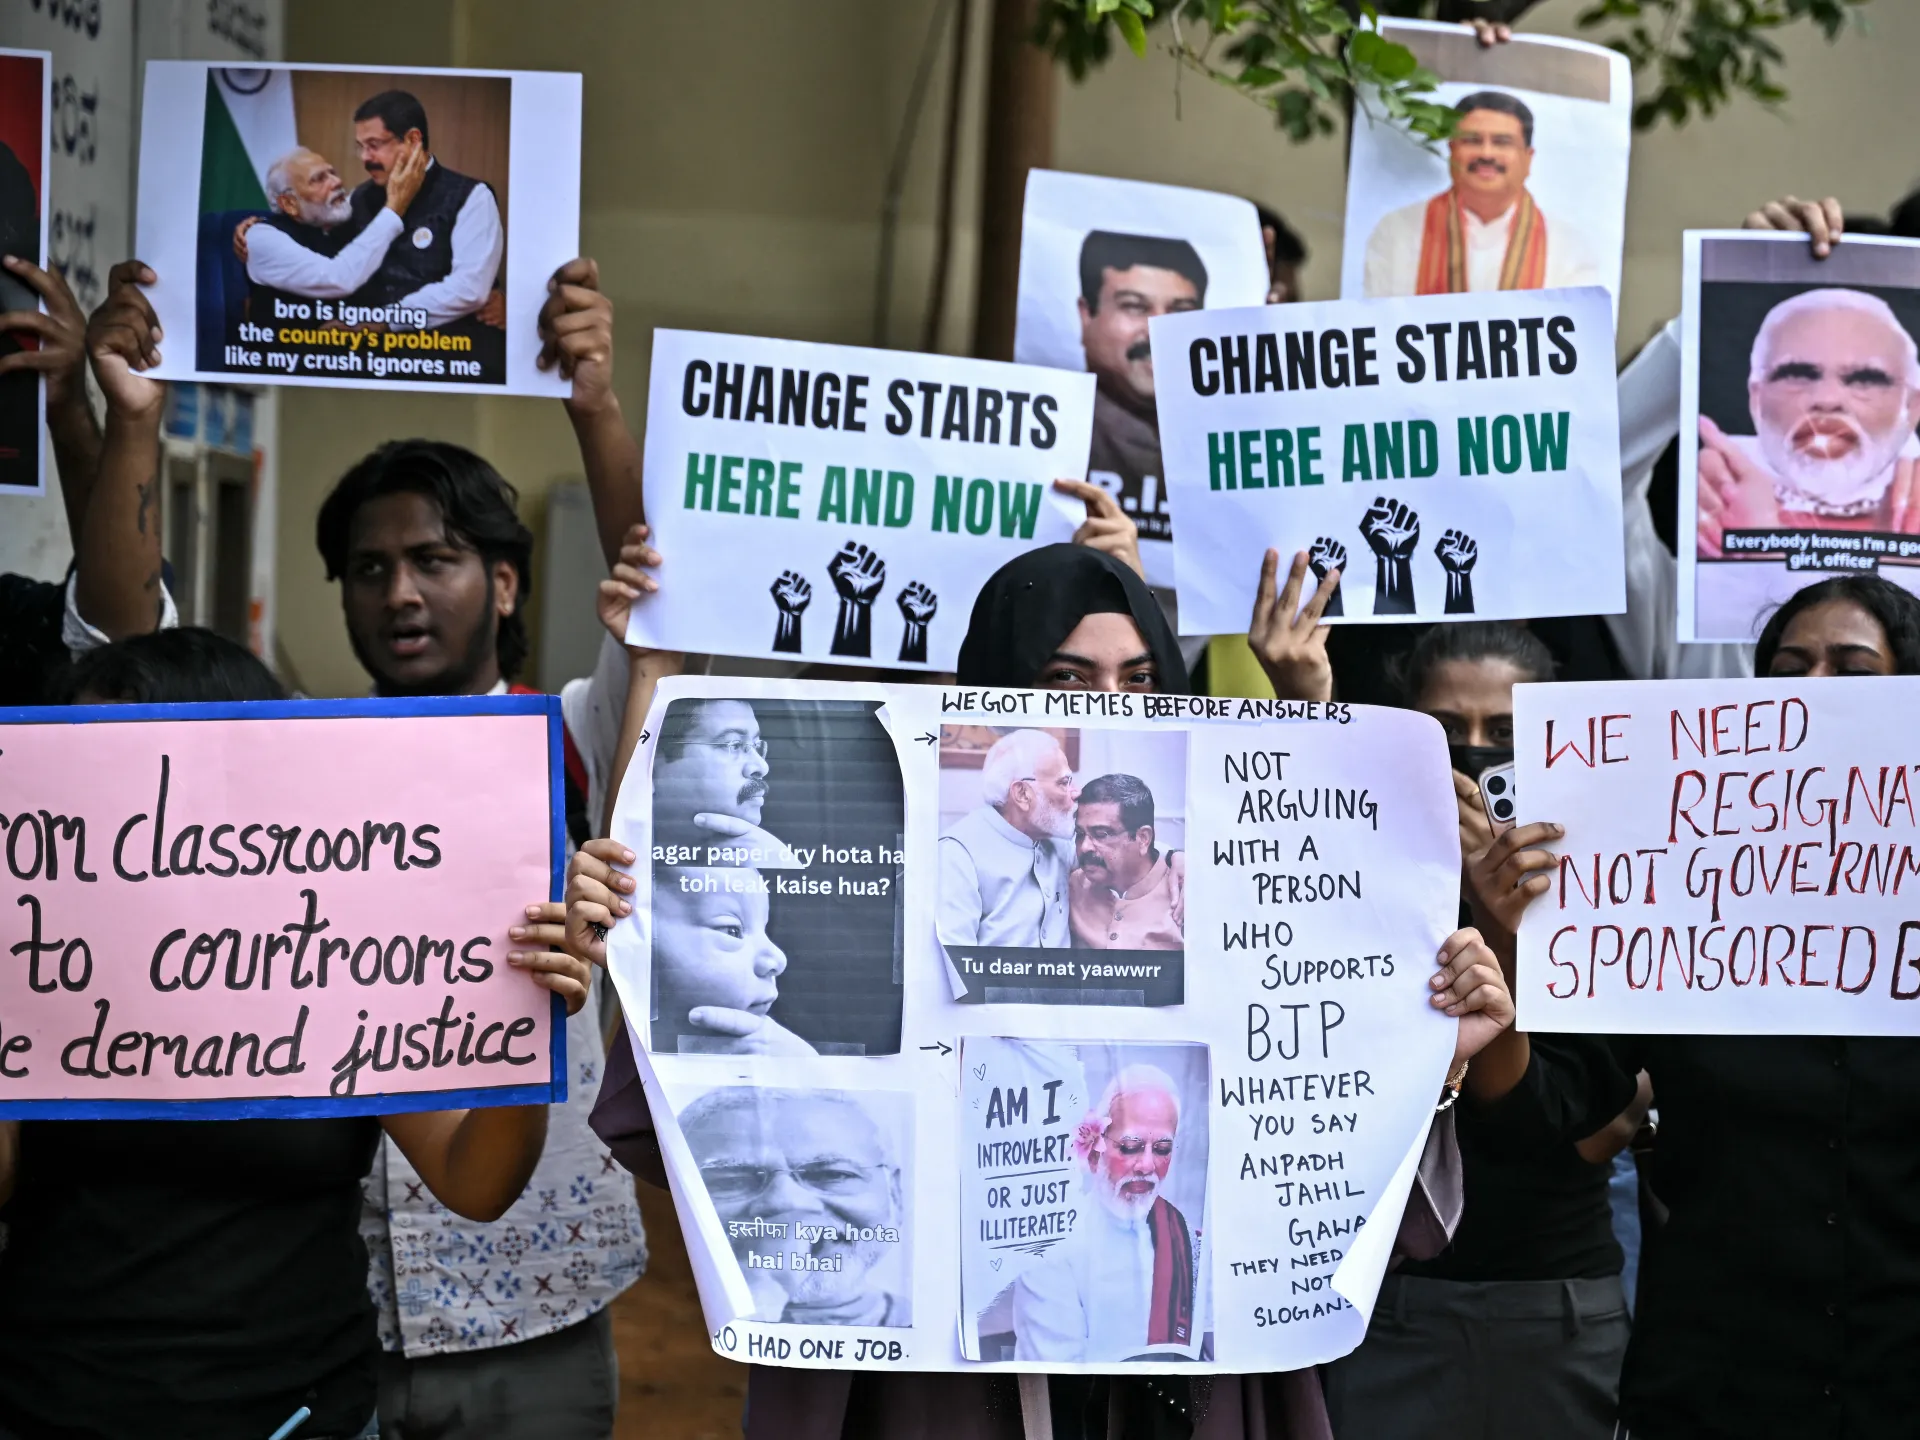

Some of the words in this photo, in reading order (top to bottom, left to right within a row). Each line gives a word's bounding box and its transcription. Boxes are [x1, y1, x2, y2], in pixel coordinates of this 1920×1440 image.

[274, 299, 310, 320] bro
[316, 300, 333, 321] is
[339, 302, 427, 329] ignoring
[238, 323, 274, 343] the
[383, 331, 472, 352] problem
[224, 346, 262, 366] like
[267, 352, 299, 373] my
[304, 351, 362, 371] crush
[367, 352, 445, 377] ignores
[450, 360, 481, 376] me
[1189, 326, 1380, 397] CHANGE
[1396, 315, 1578, 384] STARTS
[682, 358, 869, 433] CHANGE
[885, 378, 1058, 450] STARTS
[1207, 426, 1325, 491] HERE
[1341, 419, 1439, 483] AND
[1457, 411, 1570, 476] NOW
[683, 452, 803, 519] HERE
[817, 465, 915, 530] AND
[931, 474, 1043, 540] NOW
[1725, 533, 1810, 552] Everybody
[1811, 535, 1861, 551] knows
[1888, 541, 1897, 552] a
[1790, 552, 1822, 570] girl,
[1824, 552, 1876, 569] officer
[1045, 693, 1134, 718] MEMES
[1237, 698, 1352, 725] ANSWERS
[1545, 713, 1631, 769] WE
[1670, 697, 1809, 761] NEED
[1225, 751, 1290, 783] NOT
[113, 754, 442, 882] classrooms
[1237, 788, 1378, 831] ARGUING
[652, 845, 701, 865] agar
[707, 846, 772, 866] paper
[778, 844, 816, 868] dry
[822, 845, 875, 865] hota
[1214, 839, 1279, 866] WITH
[1298, 835, 1319, 862] A
[680, 874, 718, 893] toh
[725, 875, 770, 894] leak
[776, 875, 832, 895] kaise
[838, 877, 891, 897] hua?
[1252, 870, 1361, 905] PERSON
[1559, 847, 1668, 910] NOT
[10, 894, 93, 993] to
[150, 889, 494, 992] courtrooms
[1223, 921, 1293, 951] WHO
[961, 957, 984, 974] Tu
[989, 958, 1033, 976] daar
[1037, 960, 1075, 977] mat
[1081, 962, 1162, 980] yaawwrr
[1261, 954, 1395, 991] SUPPORTS
[1546, 924, 1878, 999] SPONSORED
[61, 999, 310, 1079] demand
[330, 995, 536, 1097] justice
[1247, 1001, 1345, 1062] BJP
[985, 1086, 1028, 1129] AM
[1042, 1079, 1065, 1126] I
[1220, 1070, 1374, 1107] WHATEVER
[1249, 1114, 1295, 1141] YOU
[1312, 1112, 1358, 1135] SAY
[1240, 1151, 1345, 1180] ANPADH
[987, 1186, 1012, 1208] OR
[1021, 1180, 1070, 1206] JUST
[1274, 1180, 1365, 1207] JAHIL
[728, 1216, 789, 1240] इस्तीफा
[795, 1221, 839, 1244] kya
[845, 1222, 899, 1243] hota
[980, 1208, 1077, 1242] ILLITERATE?
[748, 1251, 784, 1270] hai
[790, 1252, 842, 1272] bhai
[1230, 1257, 1279, 1277] THEY
[1291, 1249, 1343, 1269] NEED
[1292, 1274, 1334, 1295] NOT
[748, 1333, 791, 1359] HAD
[799, 1339, 845, 1360] ONE
[855, 1339, 910, 1361] JOB.
